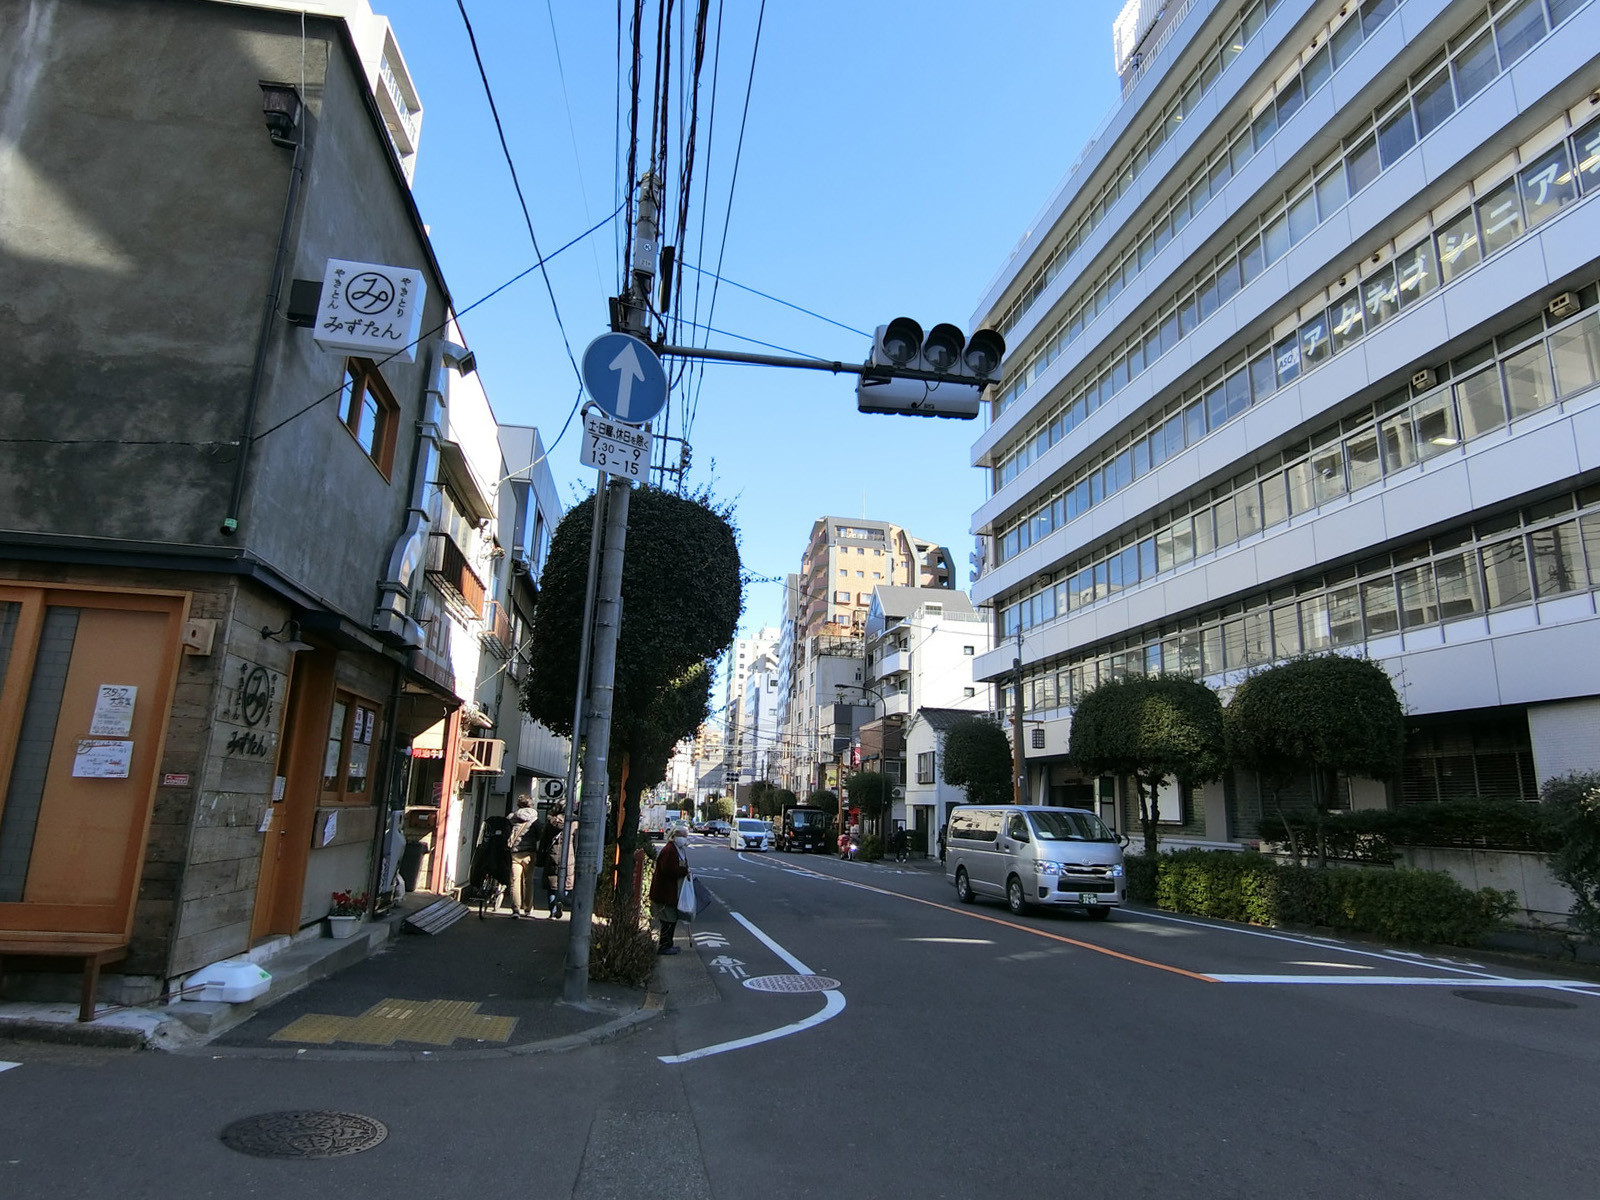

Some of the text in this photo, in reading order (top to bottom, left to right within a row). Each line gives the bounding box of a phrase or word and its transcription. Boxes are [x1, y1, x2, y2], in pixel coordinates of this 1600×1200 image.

[328, 268, 345, 310] やきとん
[351, 278, 389, 309] み
[396, 277, 412, 318] やきとり
[323, 316, 402, 340] みずたん
[550, 783, 561, 796] P
